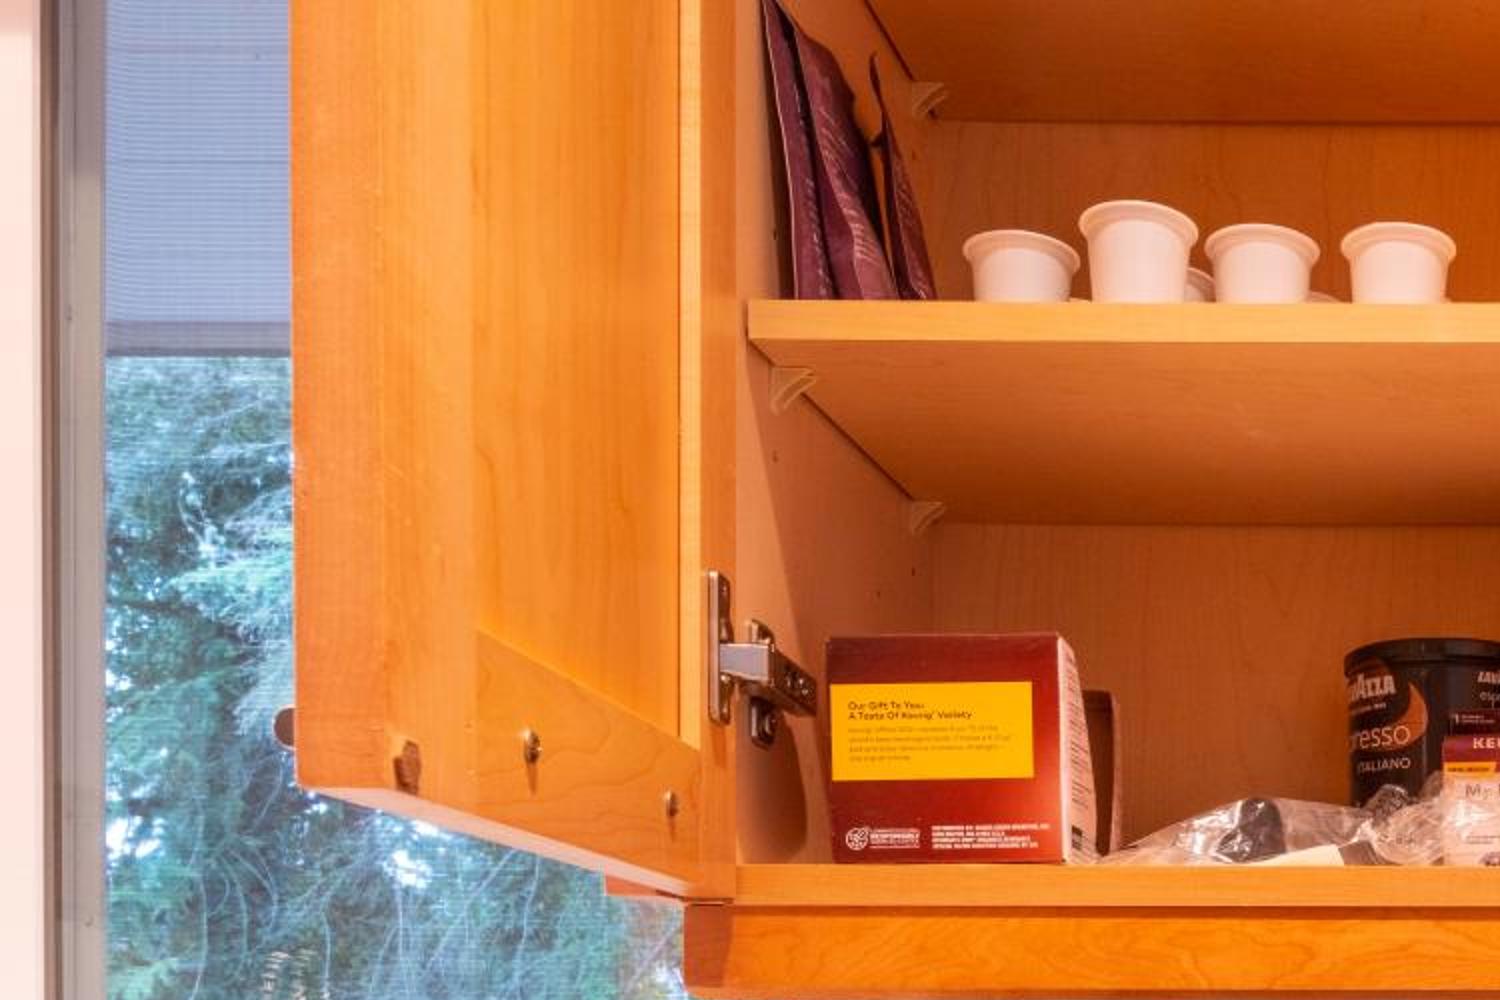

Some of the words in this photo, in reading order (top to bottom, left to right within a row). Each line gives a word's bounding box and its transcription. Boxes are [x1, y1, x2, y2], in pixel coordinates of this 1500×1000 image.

[847, 701, 866, 710] Our
[868, 701, 889, 710] Gift
[891, 701, 901, 709] To
[848, 712, 856, 720] A
[858, 712, 884, 720] Taste
[887, 712, 899, 720] Of
[937, 711, 973, 721] Variety
